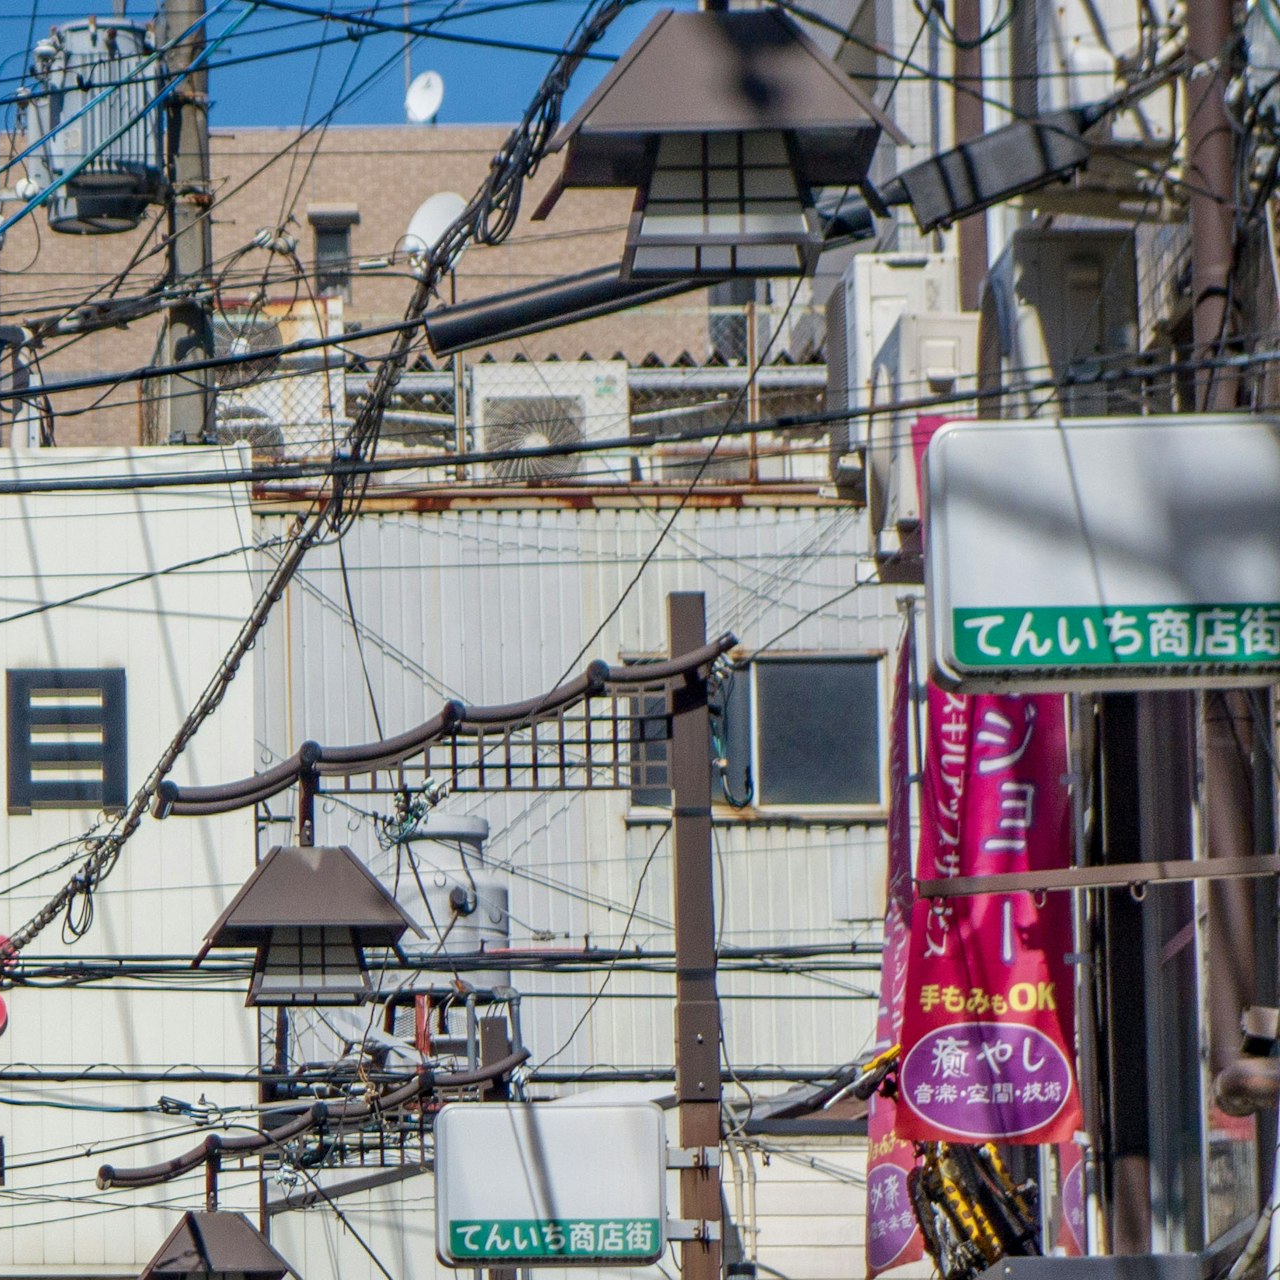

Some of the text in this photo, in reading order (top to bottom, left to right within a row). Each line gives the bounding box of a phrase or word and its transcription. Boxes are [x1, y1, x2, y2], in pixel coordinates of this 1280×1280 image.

[963, 607, 1279, 659] てんいち商店街
[919, 983, 1057, 1013] 手もみもOK
[930, 1036, 1047, 1080] 癒やし
[455, 1221, 653, 1254] てんいち商店街
